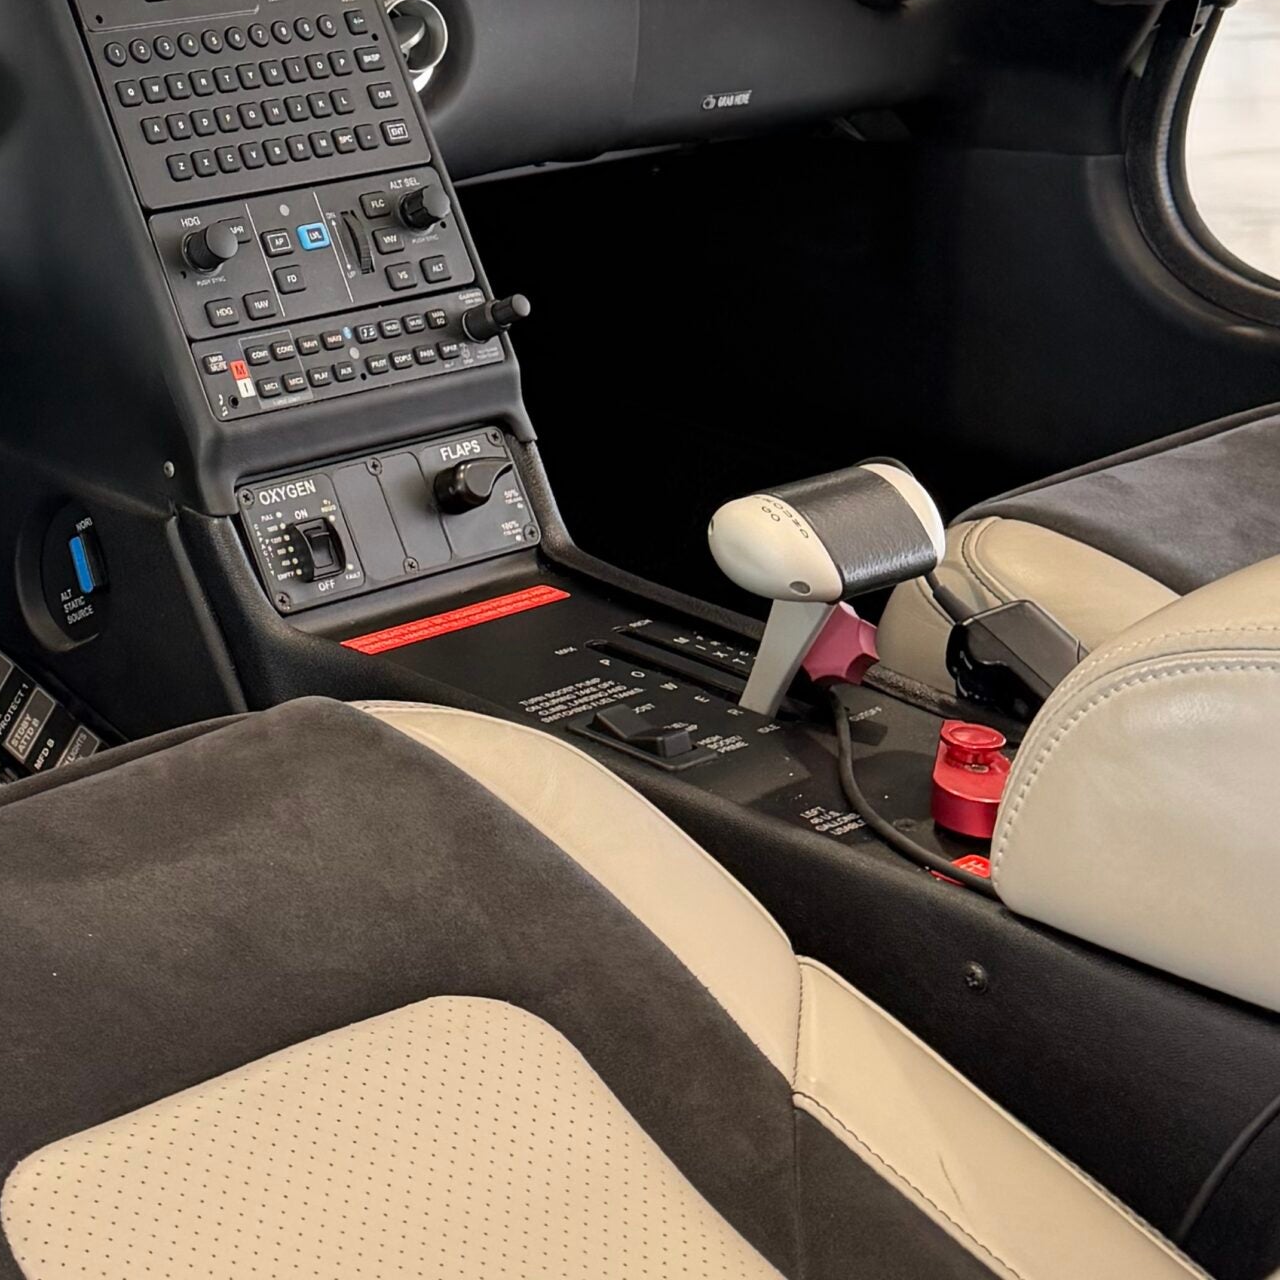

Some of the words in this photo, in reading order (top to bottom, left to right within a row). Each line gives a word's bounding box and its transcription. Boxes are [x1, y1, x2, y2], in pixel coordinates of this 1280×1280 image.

[390, 179, 403, 189] ALT
[404, 177, 421, 187] SEL
[371, 199, 385, 208] FLC
[180, 216, 201, 227] HDG
[275, 237, 285, 246] AP
[287, 274, 298, 283] FD
[397, 271, 409, 280] VS
[432, 263, 444, 273] ALT
[216, 307, 233, 317] HDG
[254, 300, 269, 309] NAV
[314, 371, 328, 380] PLAY
[371, 359, 387, 369] PILOT
[440, 440, 481, 461] FLAPS
[259, 480, 316, 505] OXYGEN
[294, 508, 308, 520] ON
[277, 571, 295, 581] EMPTY
[345, 571, 361, 580] FAULT
[318, 579, 336, 592] OFF
[60, 588, 72, 602] ALT
[63, 595, 86, 613] STATIC
[66, 604, 95, 625] SOURCE
[67, 732, 88, 764] LIGHTS
[33, 746, 50, 770] MFD
